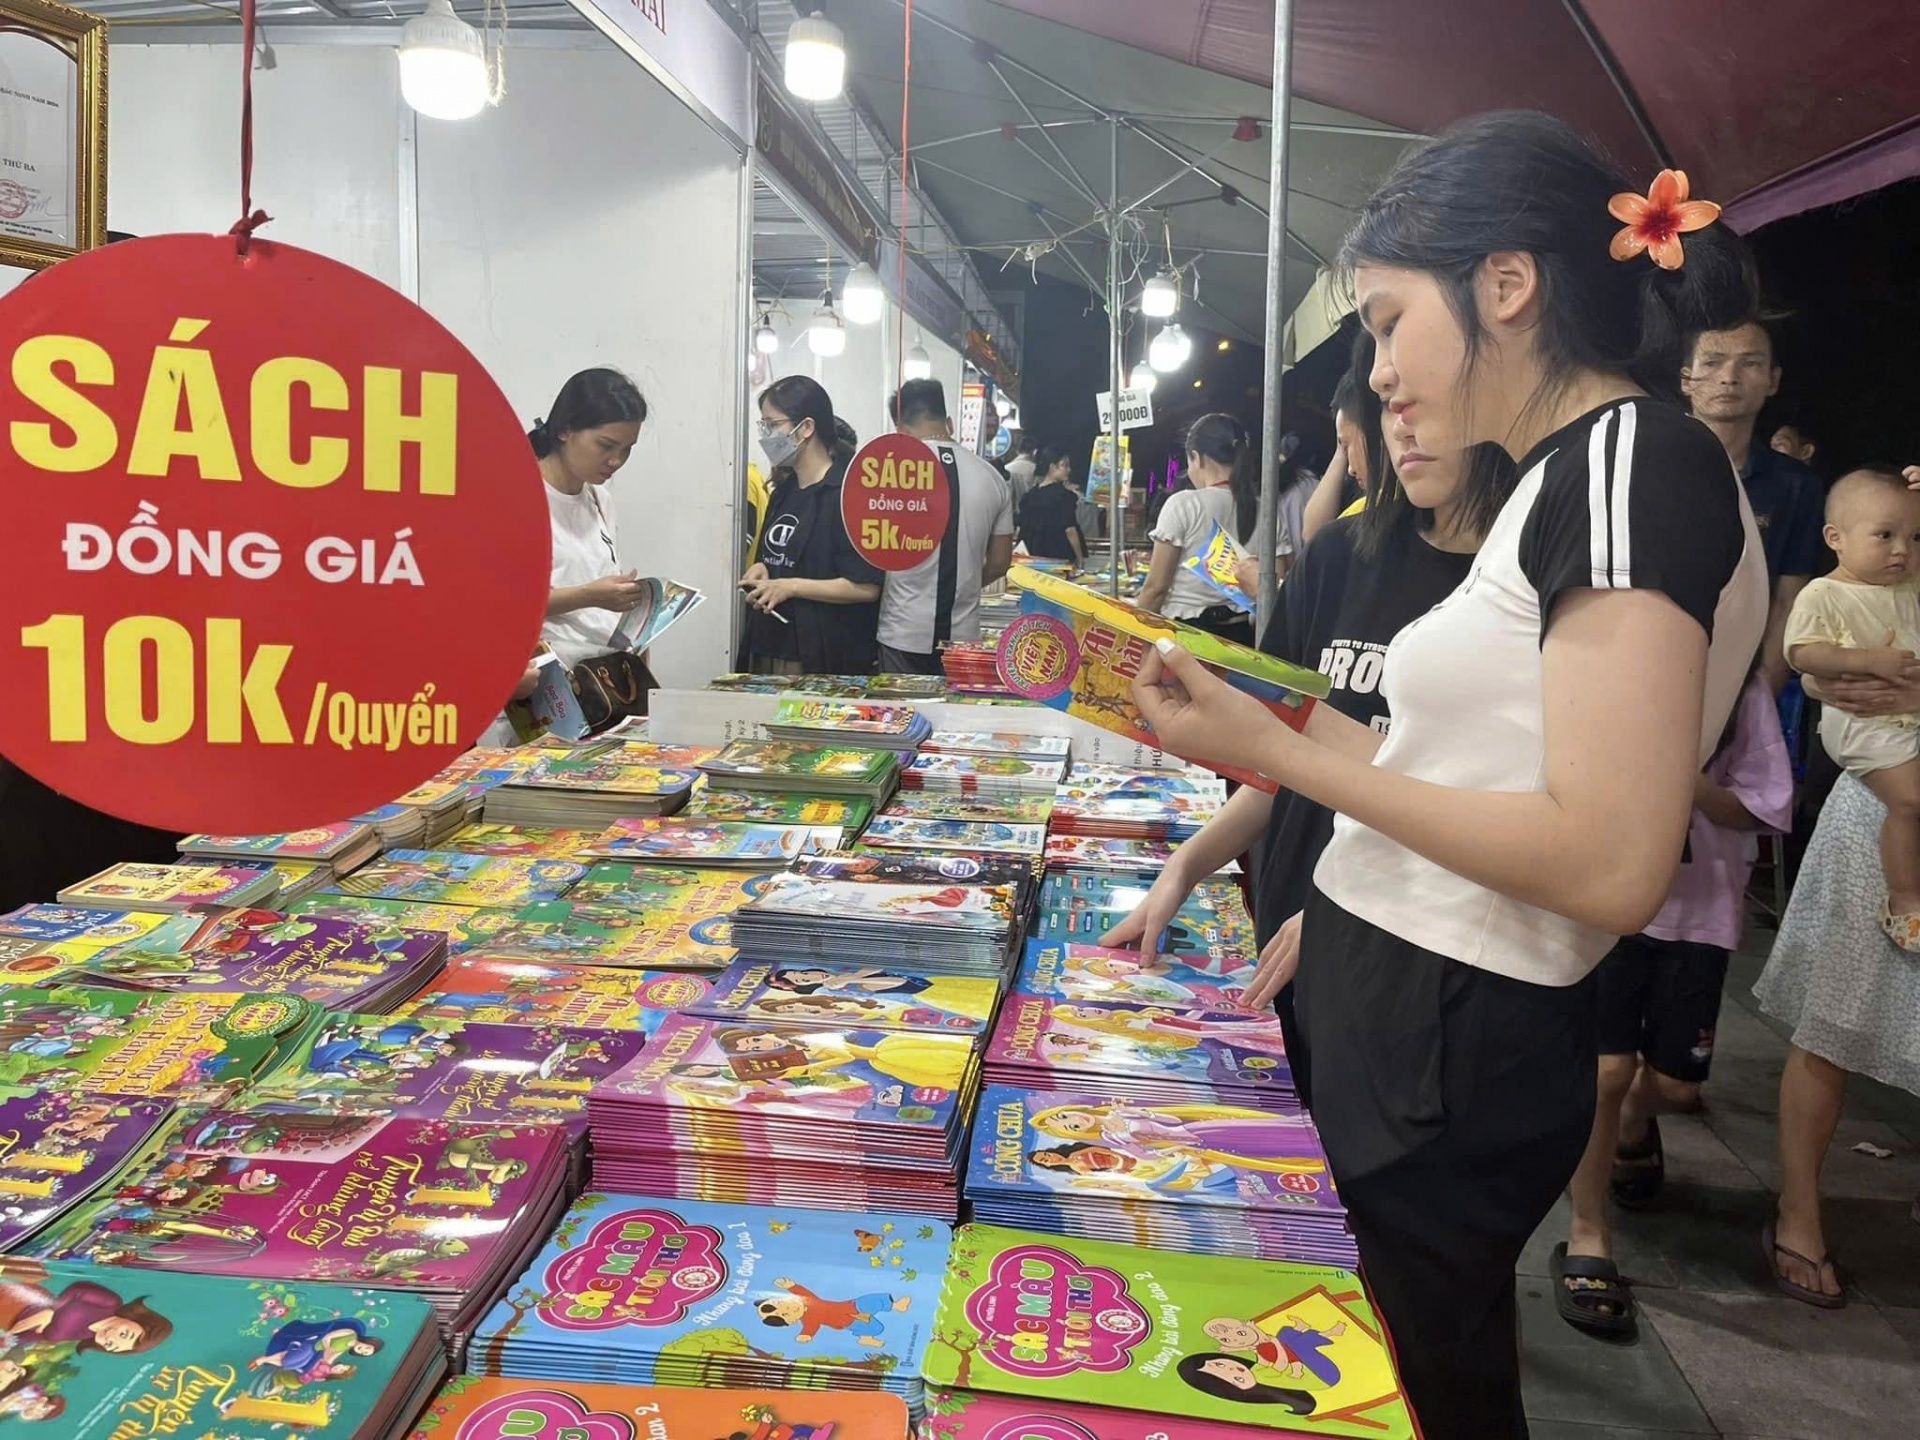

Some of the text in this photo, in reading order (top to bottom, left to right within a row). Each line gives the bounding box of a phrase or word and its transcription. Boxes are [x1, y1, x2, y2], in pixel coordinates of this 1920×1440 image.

[24, 163, 36, 172] BA
[10, 317, 458, 495] SÁCH
[860, 452, 934, 490] SÁCH
[906, 497, 928, 512] GIÁ
[62, 500, 425, 586] ĐỒNG GIÁ
[861, 519, 900, 550] 5k
[1020, 638, 1042, 673] VIỆT
[1039, 643, 1060, 678] NAM
[21, 614, 458, 753] 10k /Quyển
[994, 1102, 1024, 1139] CHÚA
[994, 1139, 1023, 1174] CÔNG
[368, 1153, 425, 1208] Truyện
[727, 1221, 748, 1231] 1
[562, 1221, 655, 1319] SẮC MÀU
[626, 1234, 688, 1306] TUỔI THƠ
[1134, 1271, 1155, 1281] 2
[996, 1258, 1055, 1364] SẮC MÀU
[1055, 1274, 1094, 1349] TUỔI THƠ
